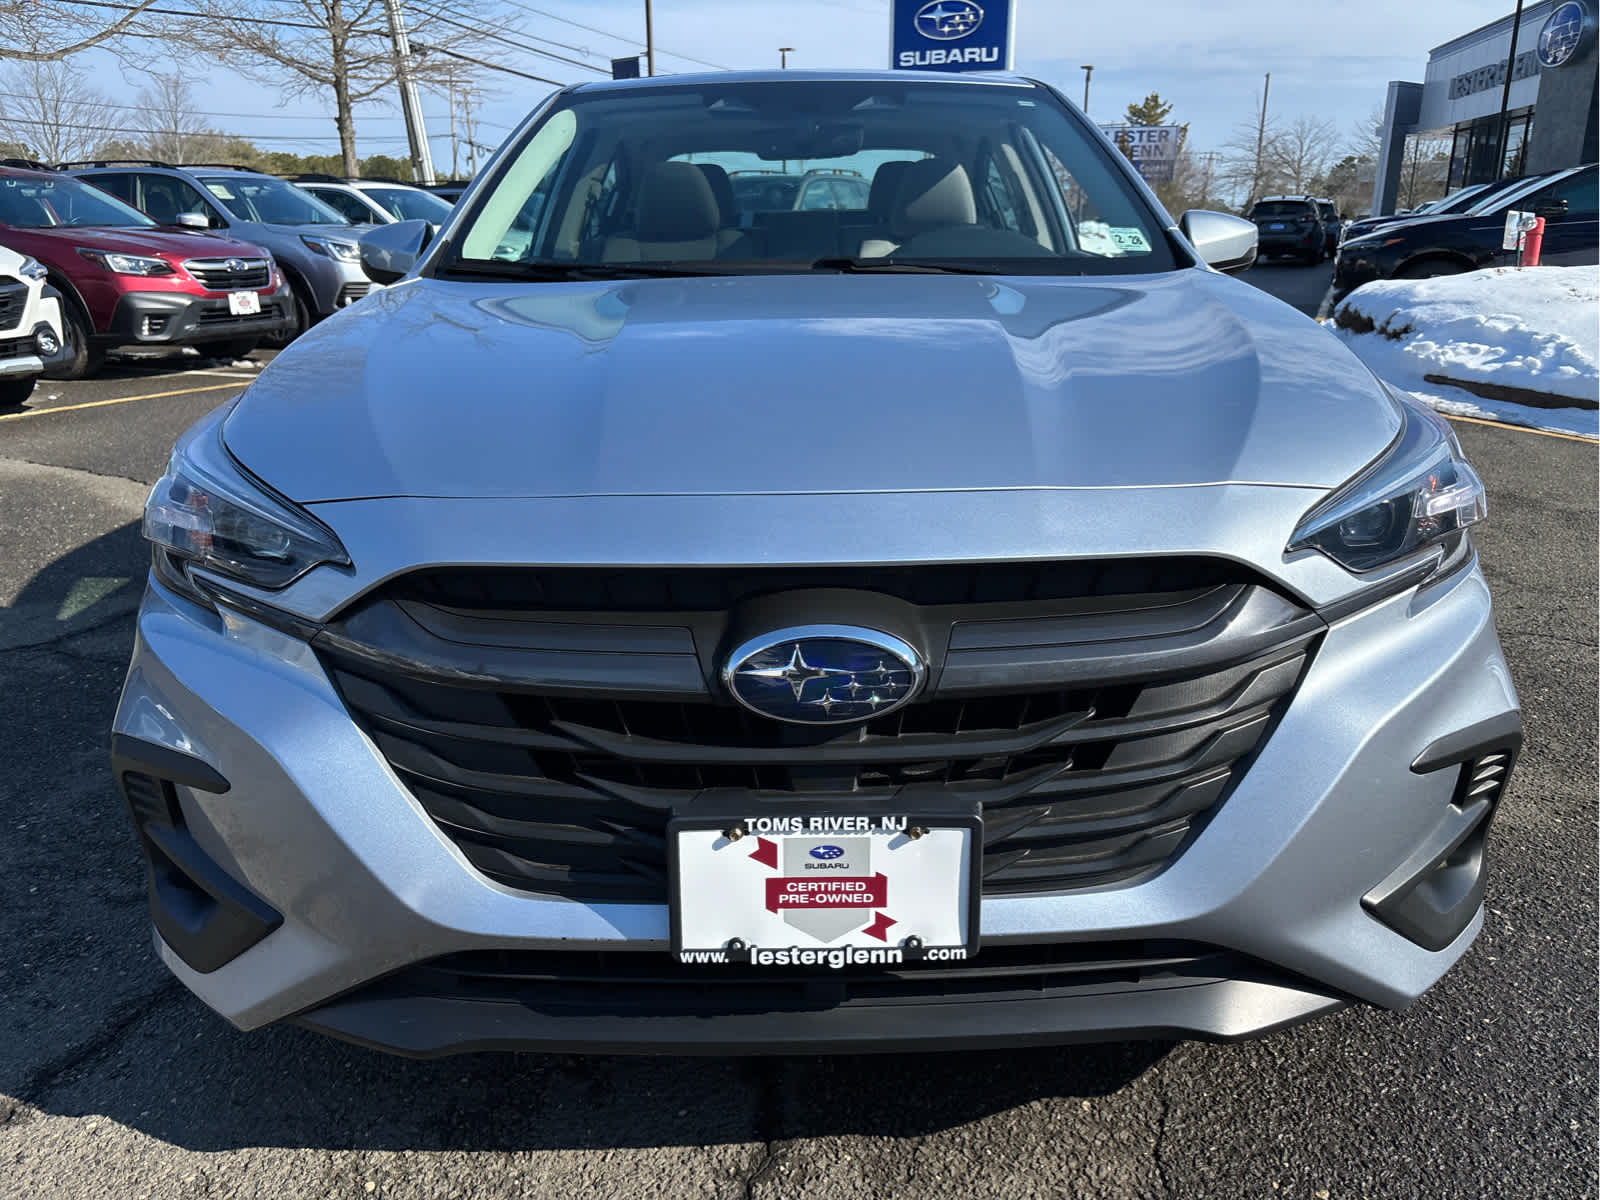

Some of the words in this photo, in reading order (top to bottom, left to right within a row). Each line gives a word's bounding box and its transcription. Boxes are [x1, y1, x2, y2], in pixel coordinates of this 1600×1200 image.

[899, 47, 999, 67] SUBARU
[1496, 48, 1541, 85] GENN
[744, 817, 803, 832] TOMS
[809, 816, 876, 831] RIVER,
[881, 816, 908, 831] NJ
[804, 862, 850, 870] SUBARU
[786, 881, 867, 892] CERTIFIED
[778, 893, 875, 904] PRE-OWNED
[680, 951, 730, 963] www.
[750, 945, 903, 968] lesterglenn
[922, 947, 967, 960] .com
